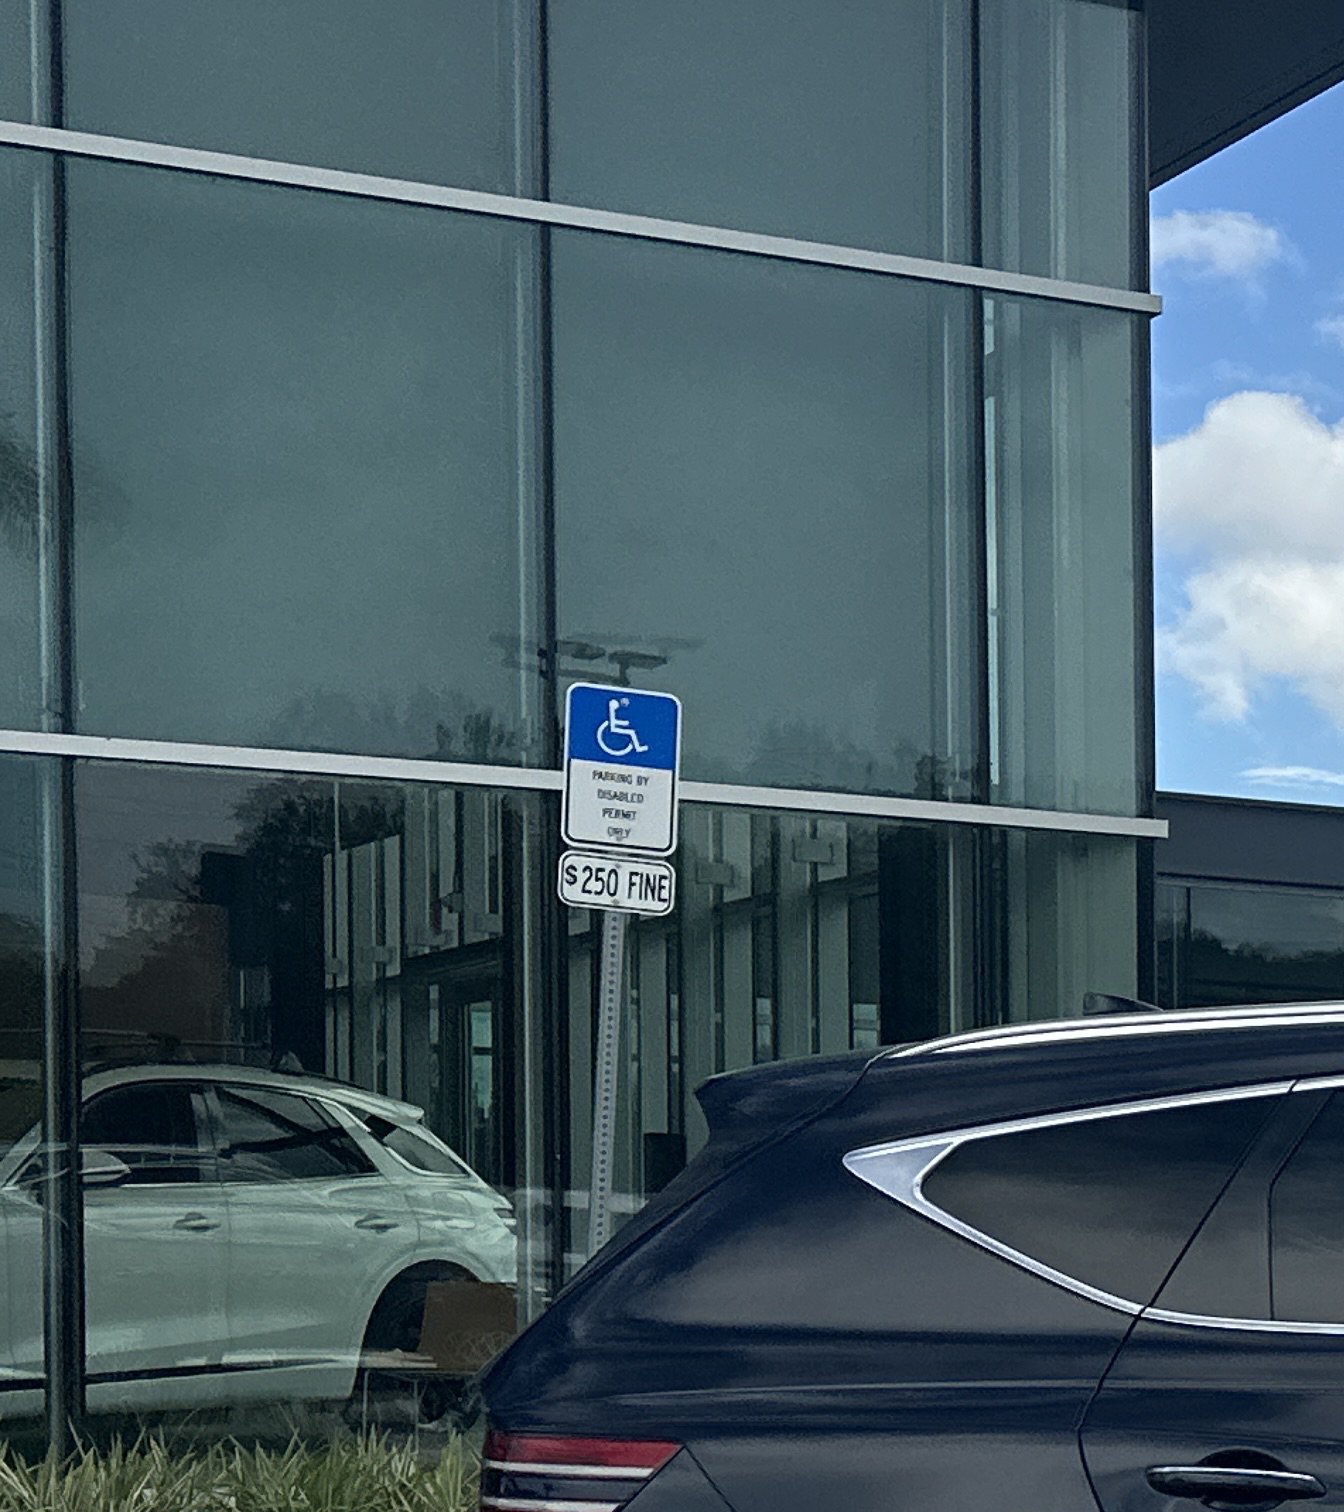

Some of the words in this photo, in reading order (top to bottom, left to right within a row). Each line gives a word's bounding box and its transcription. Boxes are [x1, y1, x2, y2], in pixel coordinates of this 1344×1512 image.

[597, 788, 644, 803] DISABLED
[565, 864, 619, 897] $250
[627, 871, 669, 903] FINE
